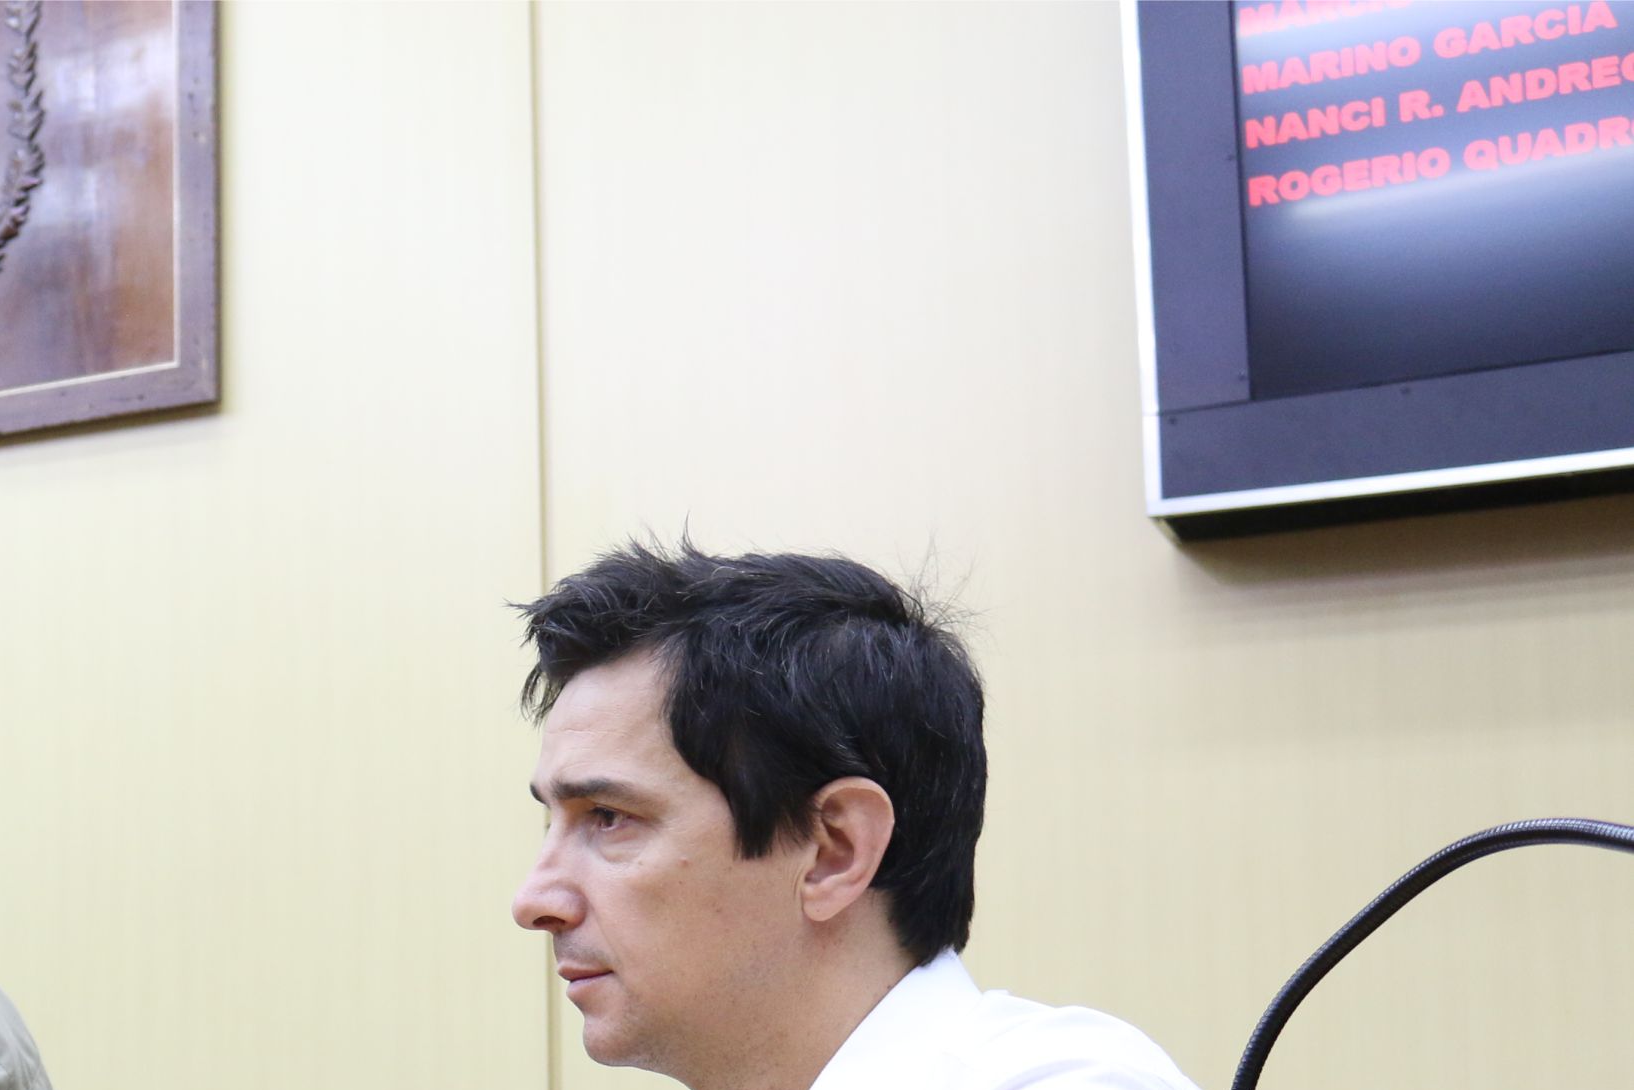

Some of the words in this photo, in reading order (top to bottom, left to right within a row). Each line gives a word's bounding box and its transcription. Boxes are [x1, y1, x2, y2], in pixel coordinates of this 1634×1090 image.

[1237, 0, 1413, 37] MAR
[1241, 36, 1422, 94] MARINO
[1433, 0, 1618, 58] GARCIA
[1245, 97, 1386, 149] NANCI
[1399, 89, 1445, 122] R.
[1248, 147, 1451, 207] ROGERIO
[1463, 116, 1634, 171] QUADR
